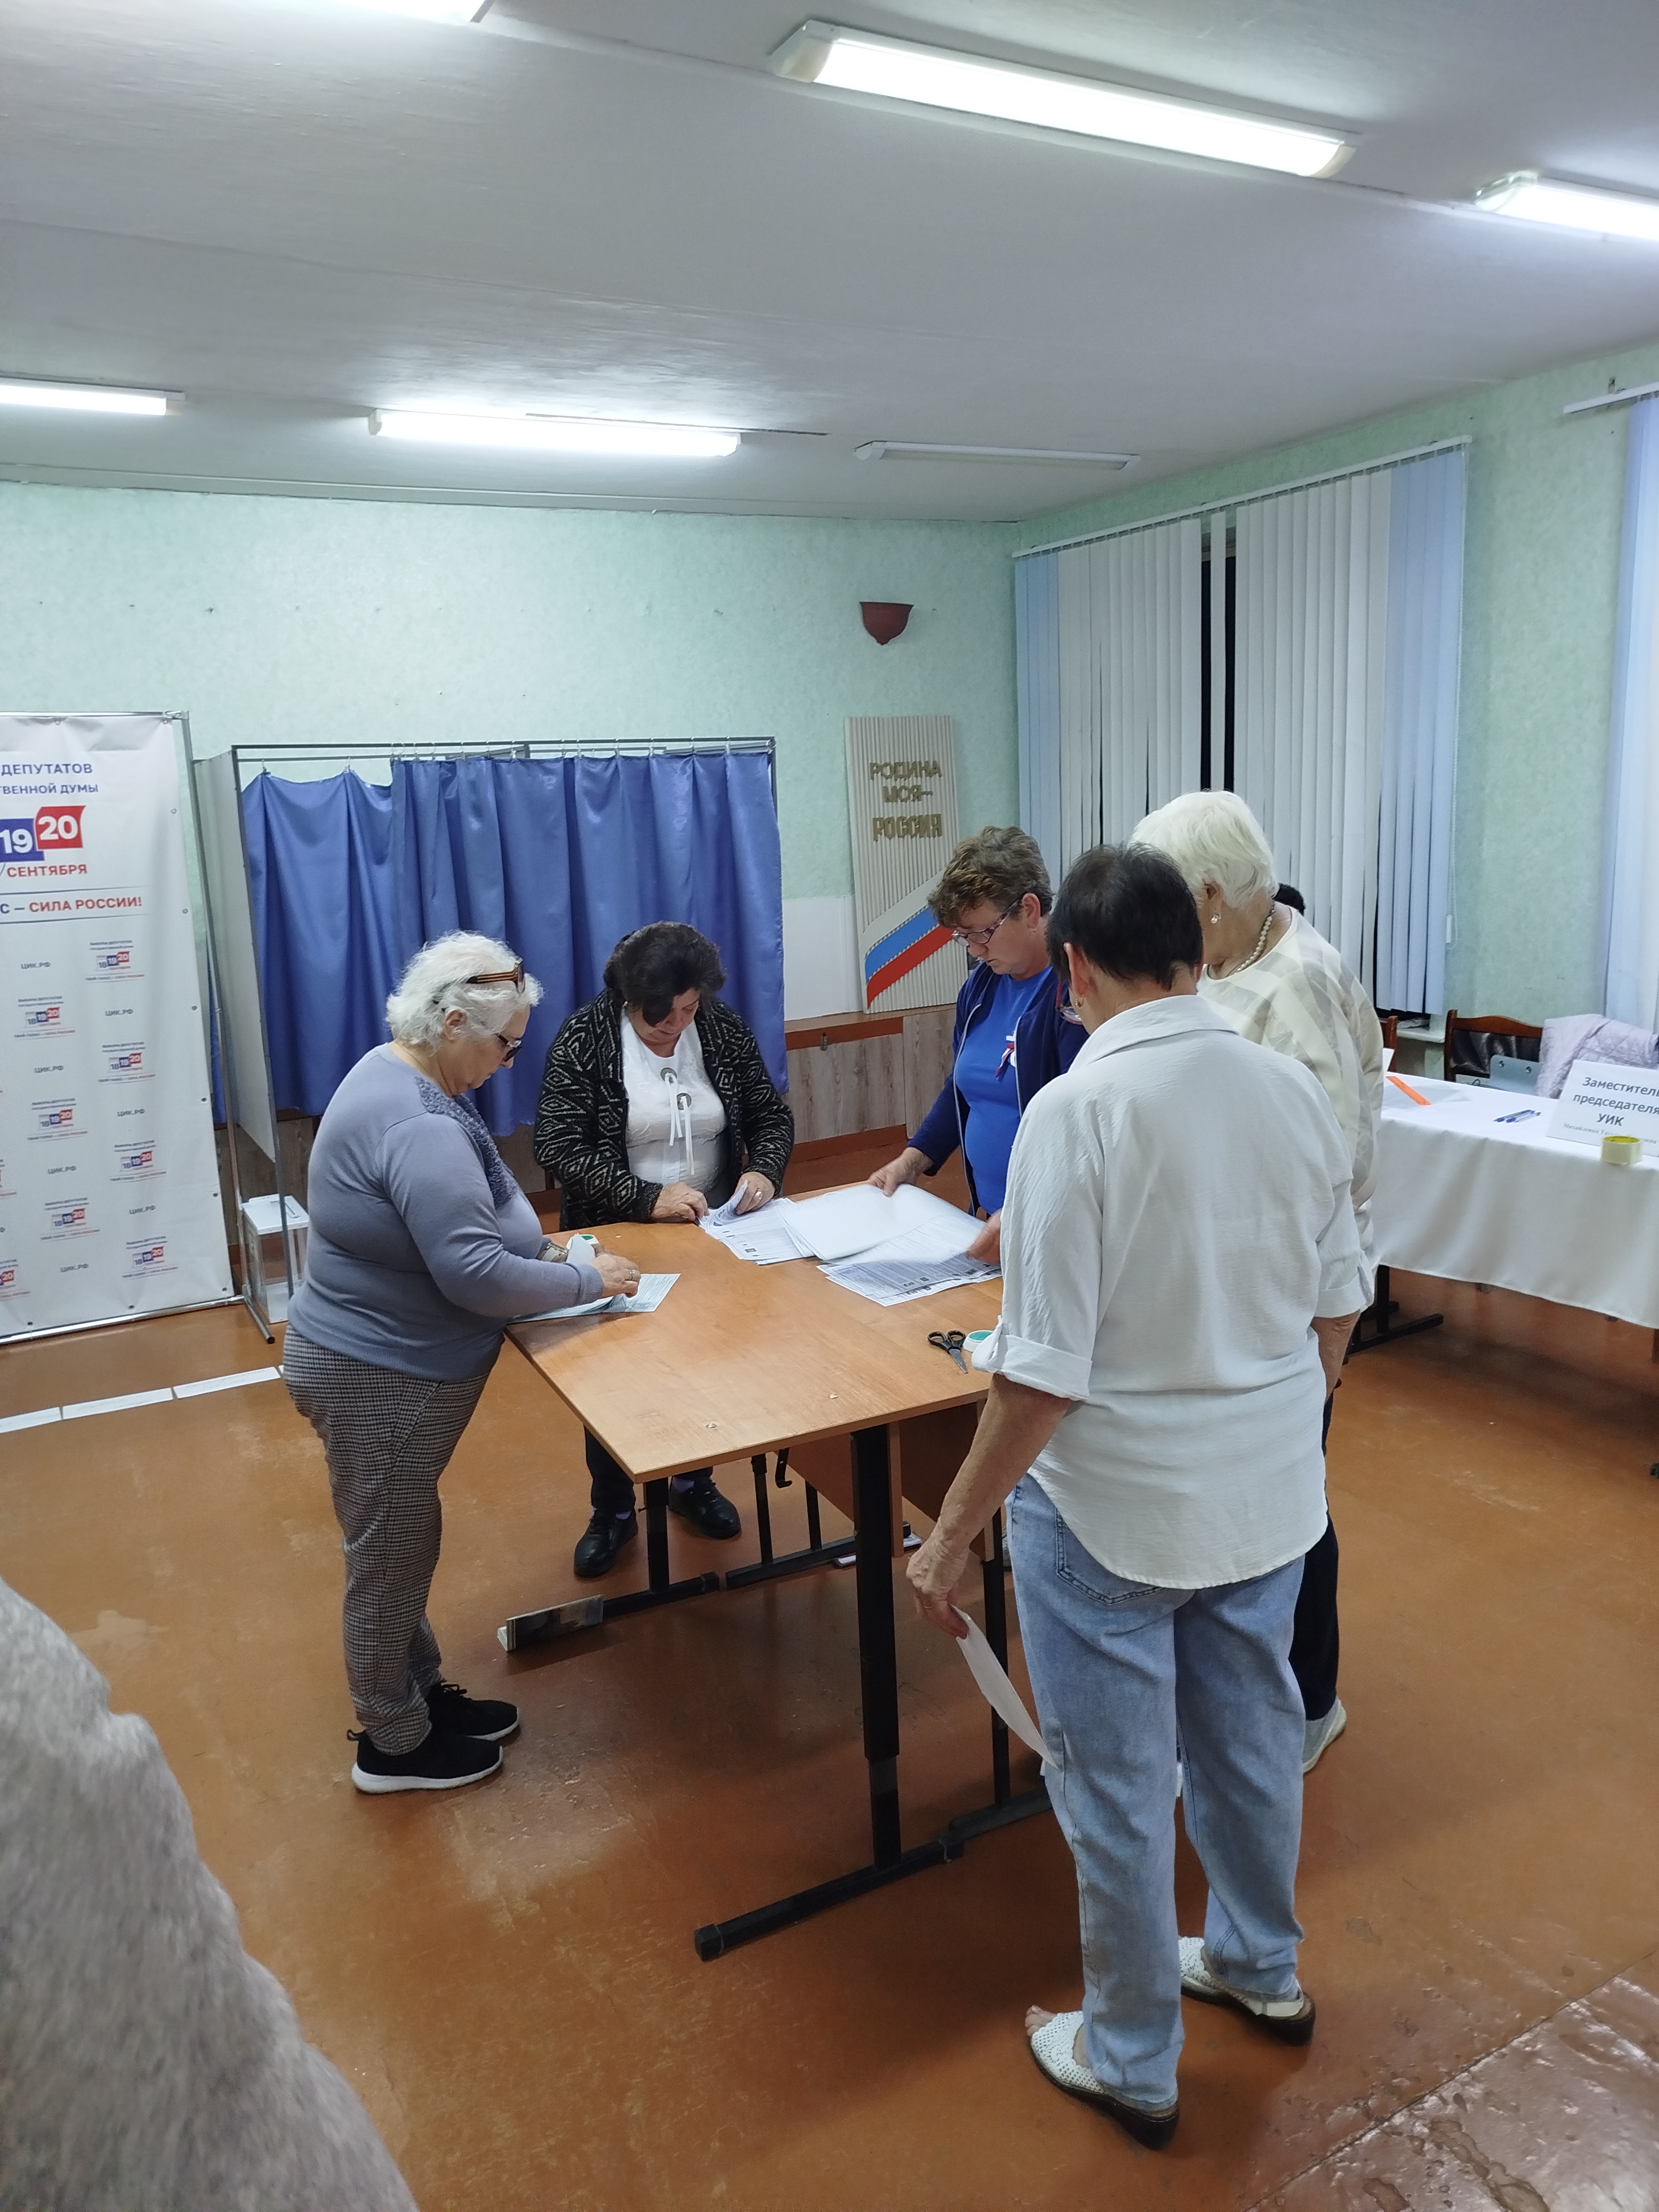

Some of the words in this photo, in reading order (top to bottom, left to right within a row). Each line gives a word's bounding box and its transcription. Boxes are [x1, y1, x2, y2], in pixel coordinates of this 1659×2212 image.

[1, 763, 93, 776] ДЕПУТАТОВ
[869, 760, 942, 781] РОДИНА
[60, 784, 98, 795] ДУМЫ
[872, 813, 943, 842] РОССИЯ
[0, 829, 33, 854] 19
[38, 815, 79, 840] 20
[7, 864, 87, 878] СЕНТЯБРЯ
[29, 900, 72, 913] СИЛА
[75, 896, 142, 910] РОССИИ!
[117, 953, 129, 961] 20
[46, 1009, 59, 1017] 20
[1573, 1094, 1659, 1115] председателя
[59, 1111, 72, 1119] 20
[1597, 1113, 1625, 1126] УИК
[140, 1152, 152, 1161] 20
[152, 1248, 163, 1257] 20
[2, 1272, 13, 1281] 20
